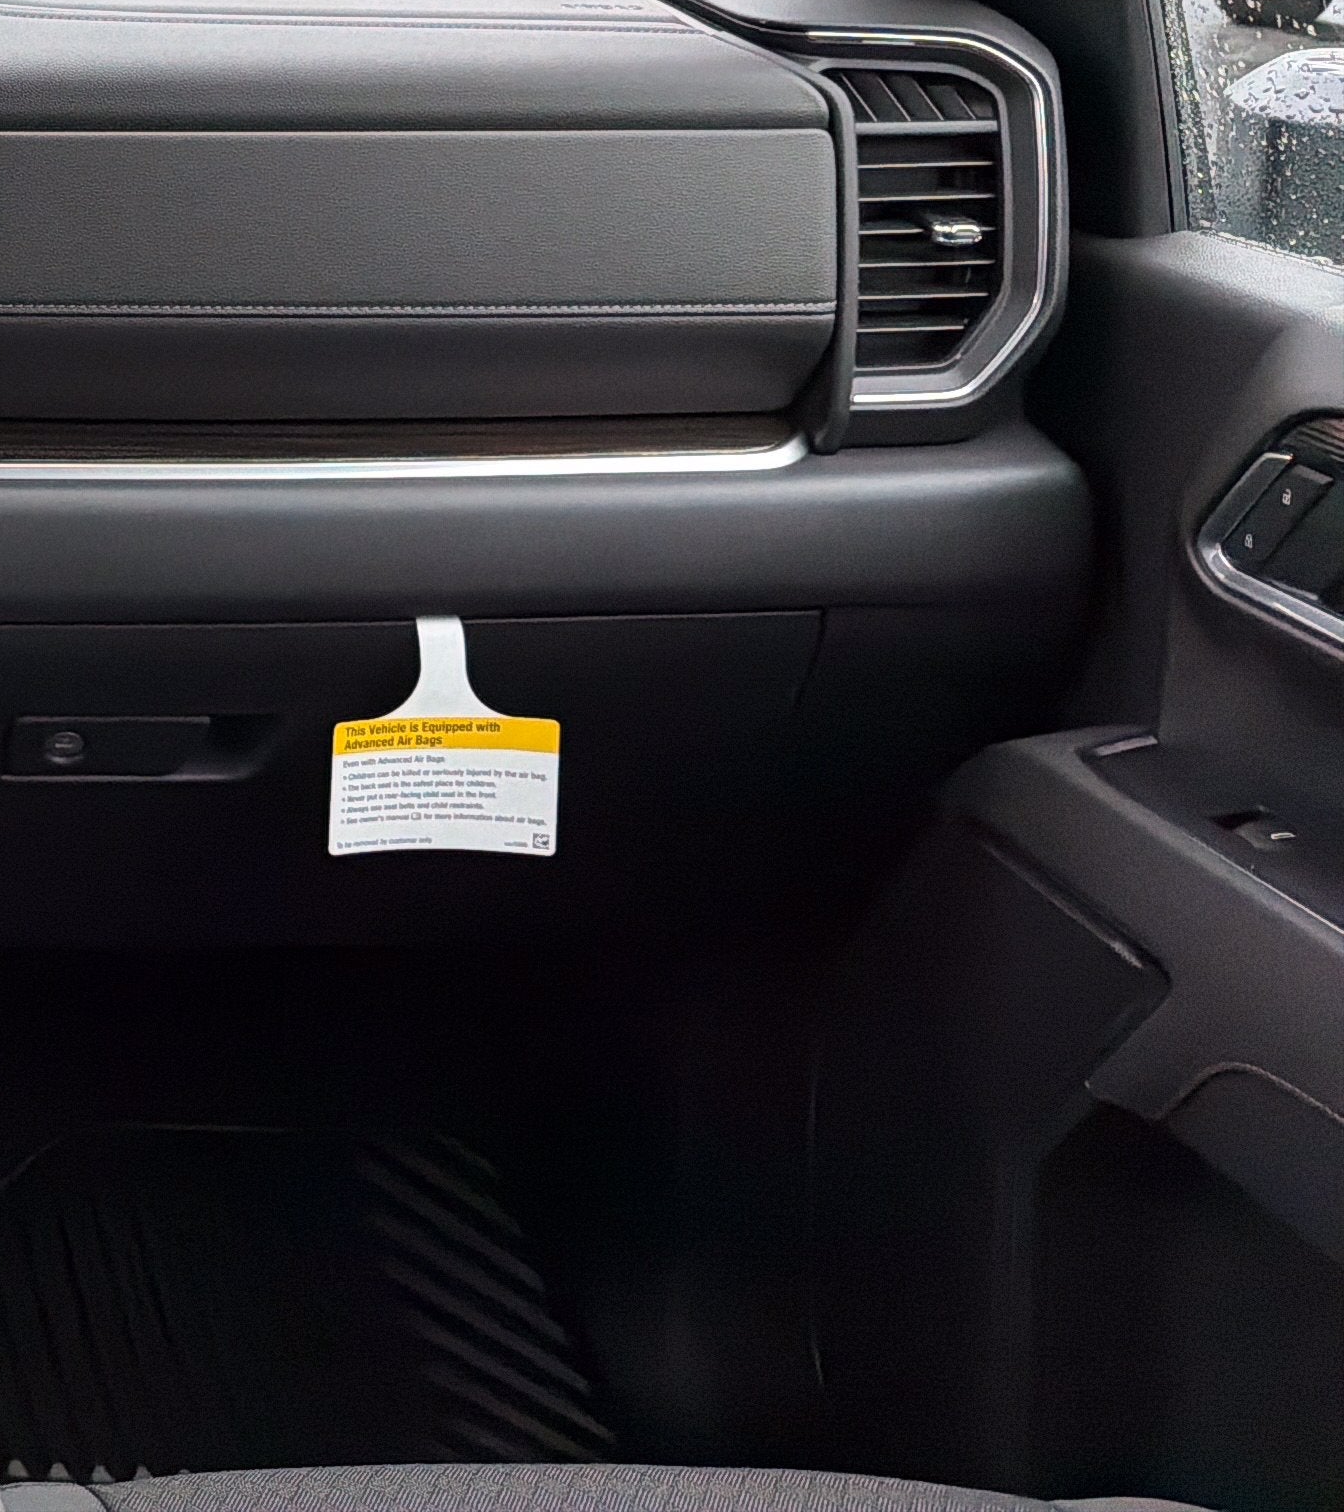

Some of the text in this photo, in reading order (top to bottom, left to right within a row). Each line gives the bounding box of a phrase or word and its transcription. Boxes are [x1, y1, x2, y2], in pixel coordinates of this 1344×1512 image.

[345, 721, 501, 738] This Vehicle is Equipped with
[344, 735, 443, 750] Advanced Air Bags
[343, 755, 445, 769] Even with Advanced Air Bags
